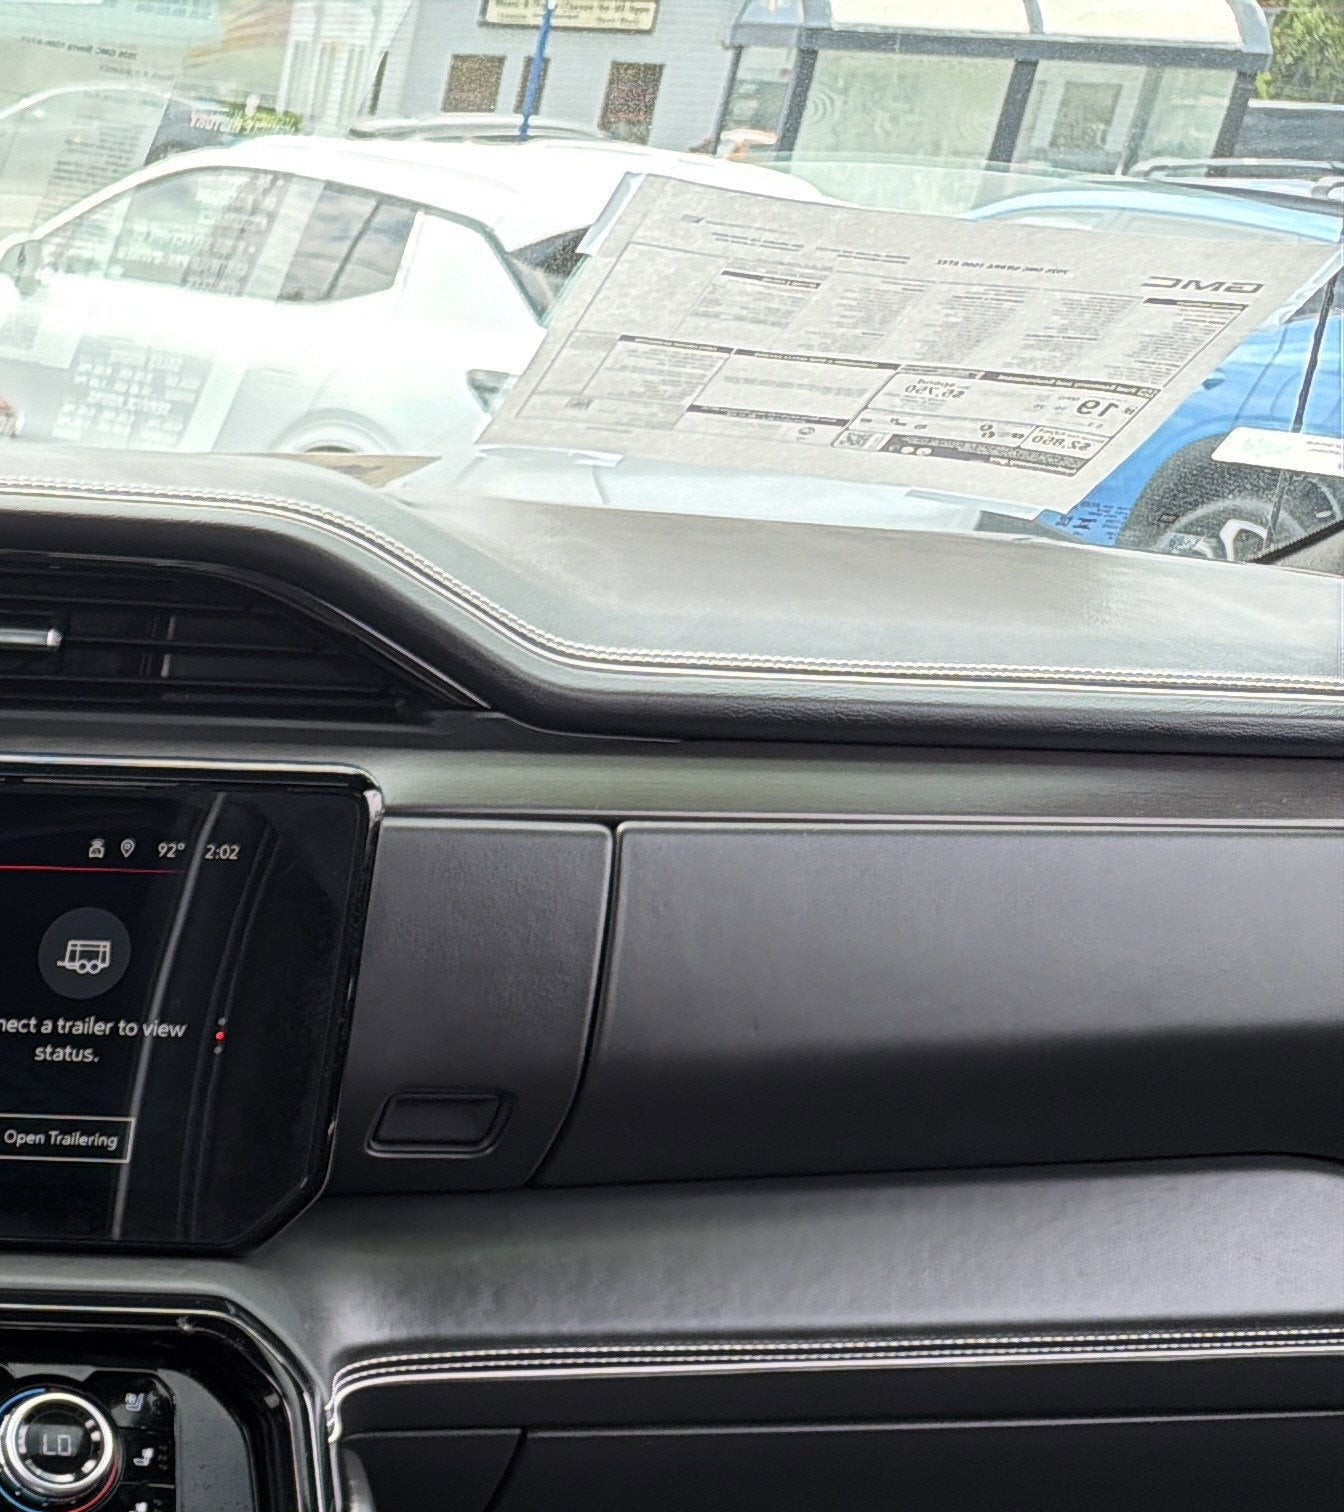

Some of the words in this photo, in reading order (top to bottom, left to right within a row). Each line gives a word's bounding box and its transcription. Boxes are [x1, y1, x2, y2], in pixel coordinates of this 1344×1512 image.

[204, 843, 242, 862] 2:02
[40, 1019, 54, 1036] a
[56, 1015, 115, 1038] trailer
[117, 1020, 138, 1039] to
[141, 1019, 187, 1040] view
[33, 1042, 100, 1064] status.
[3, 1130, 43, 1150] Open
[45, 1129, 120, 1152] Trailering
[41, 1432, 73, 1457] LO
